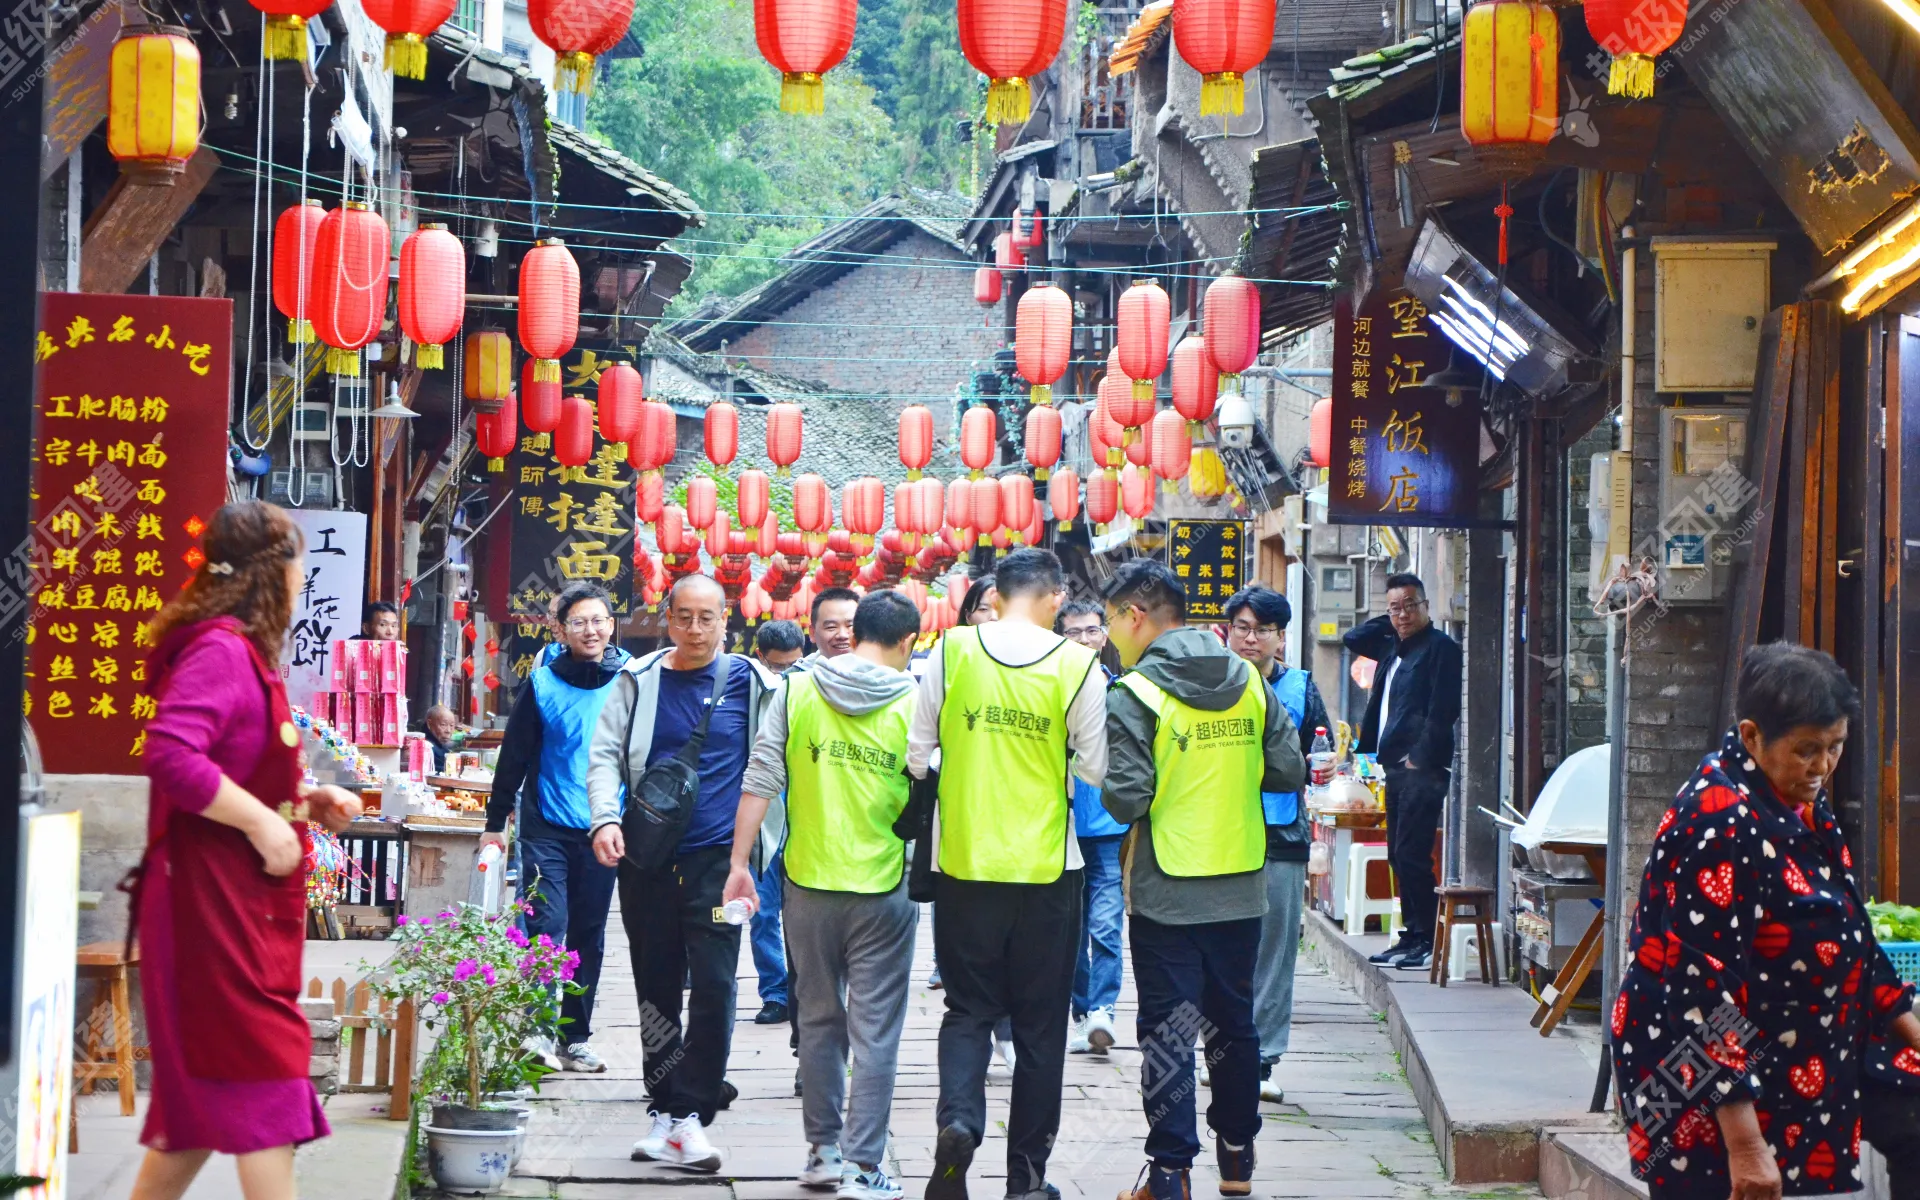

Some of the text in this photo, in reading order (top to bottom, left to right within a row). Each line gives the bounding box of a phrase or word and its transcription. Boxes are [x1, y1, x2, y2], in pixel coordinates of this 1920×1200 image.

[34, 394, 169, 422] 工肥肠粉
[1347, 317, 1372, 498] 河边就餐 中餐烧烤
[1379, 296, 1428, 513] 望江饭店
[32, 437, 167, 468] 宗牛肉面
[30, 475, 166, 505] 哒面
[29, 510, 164, 541] 肉米线
[1177, 526, 1236, 540] 奶茶
[28, 547, 164, 577] 鲜馄饨
[1176, 545, 1236, 559] 冷饮
[1176, 564, 1236, 578] 西米露
[27, 583, 163, 612] 酥豆腐脑
[1185, 602, 1227, 616] 工冰
[24, 655, 147, 684] 丝凉面
[985, 705, 1051, 735] 超级团建
[1196, 718, 1255, 740] 超级团建
[829, 740, 896, 770] 超级团建
[1197, 742, 1217, 750] SUPER
[828, 760, 848, 768] SUPER
